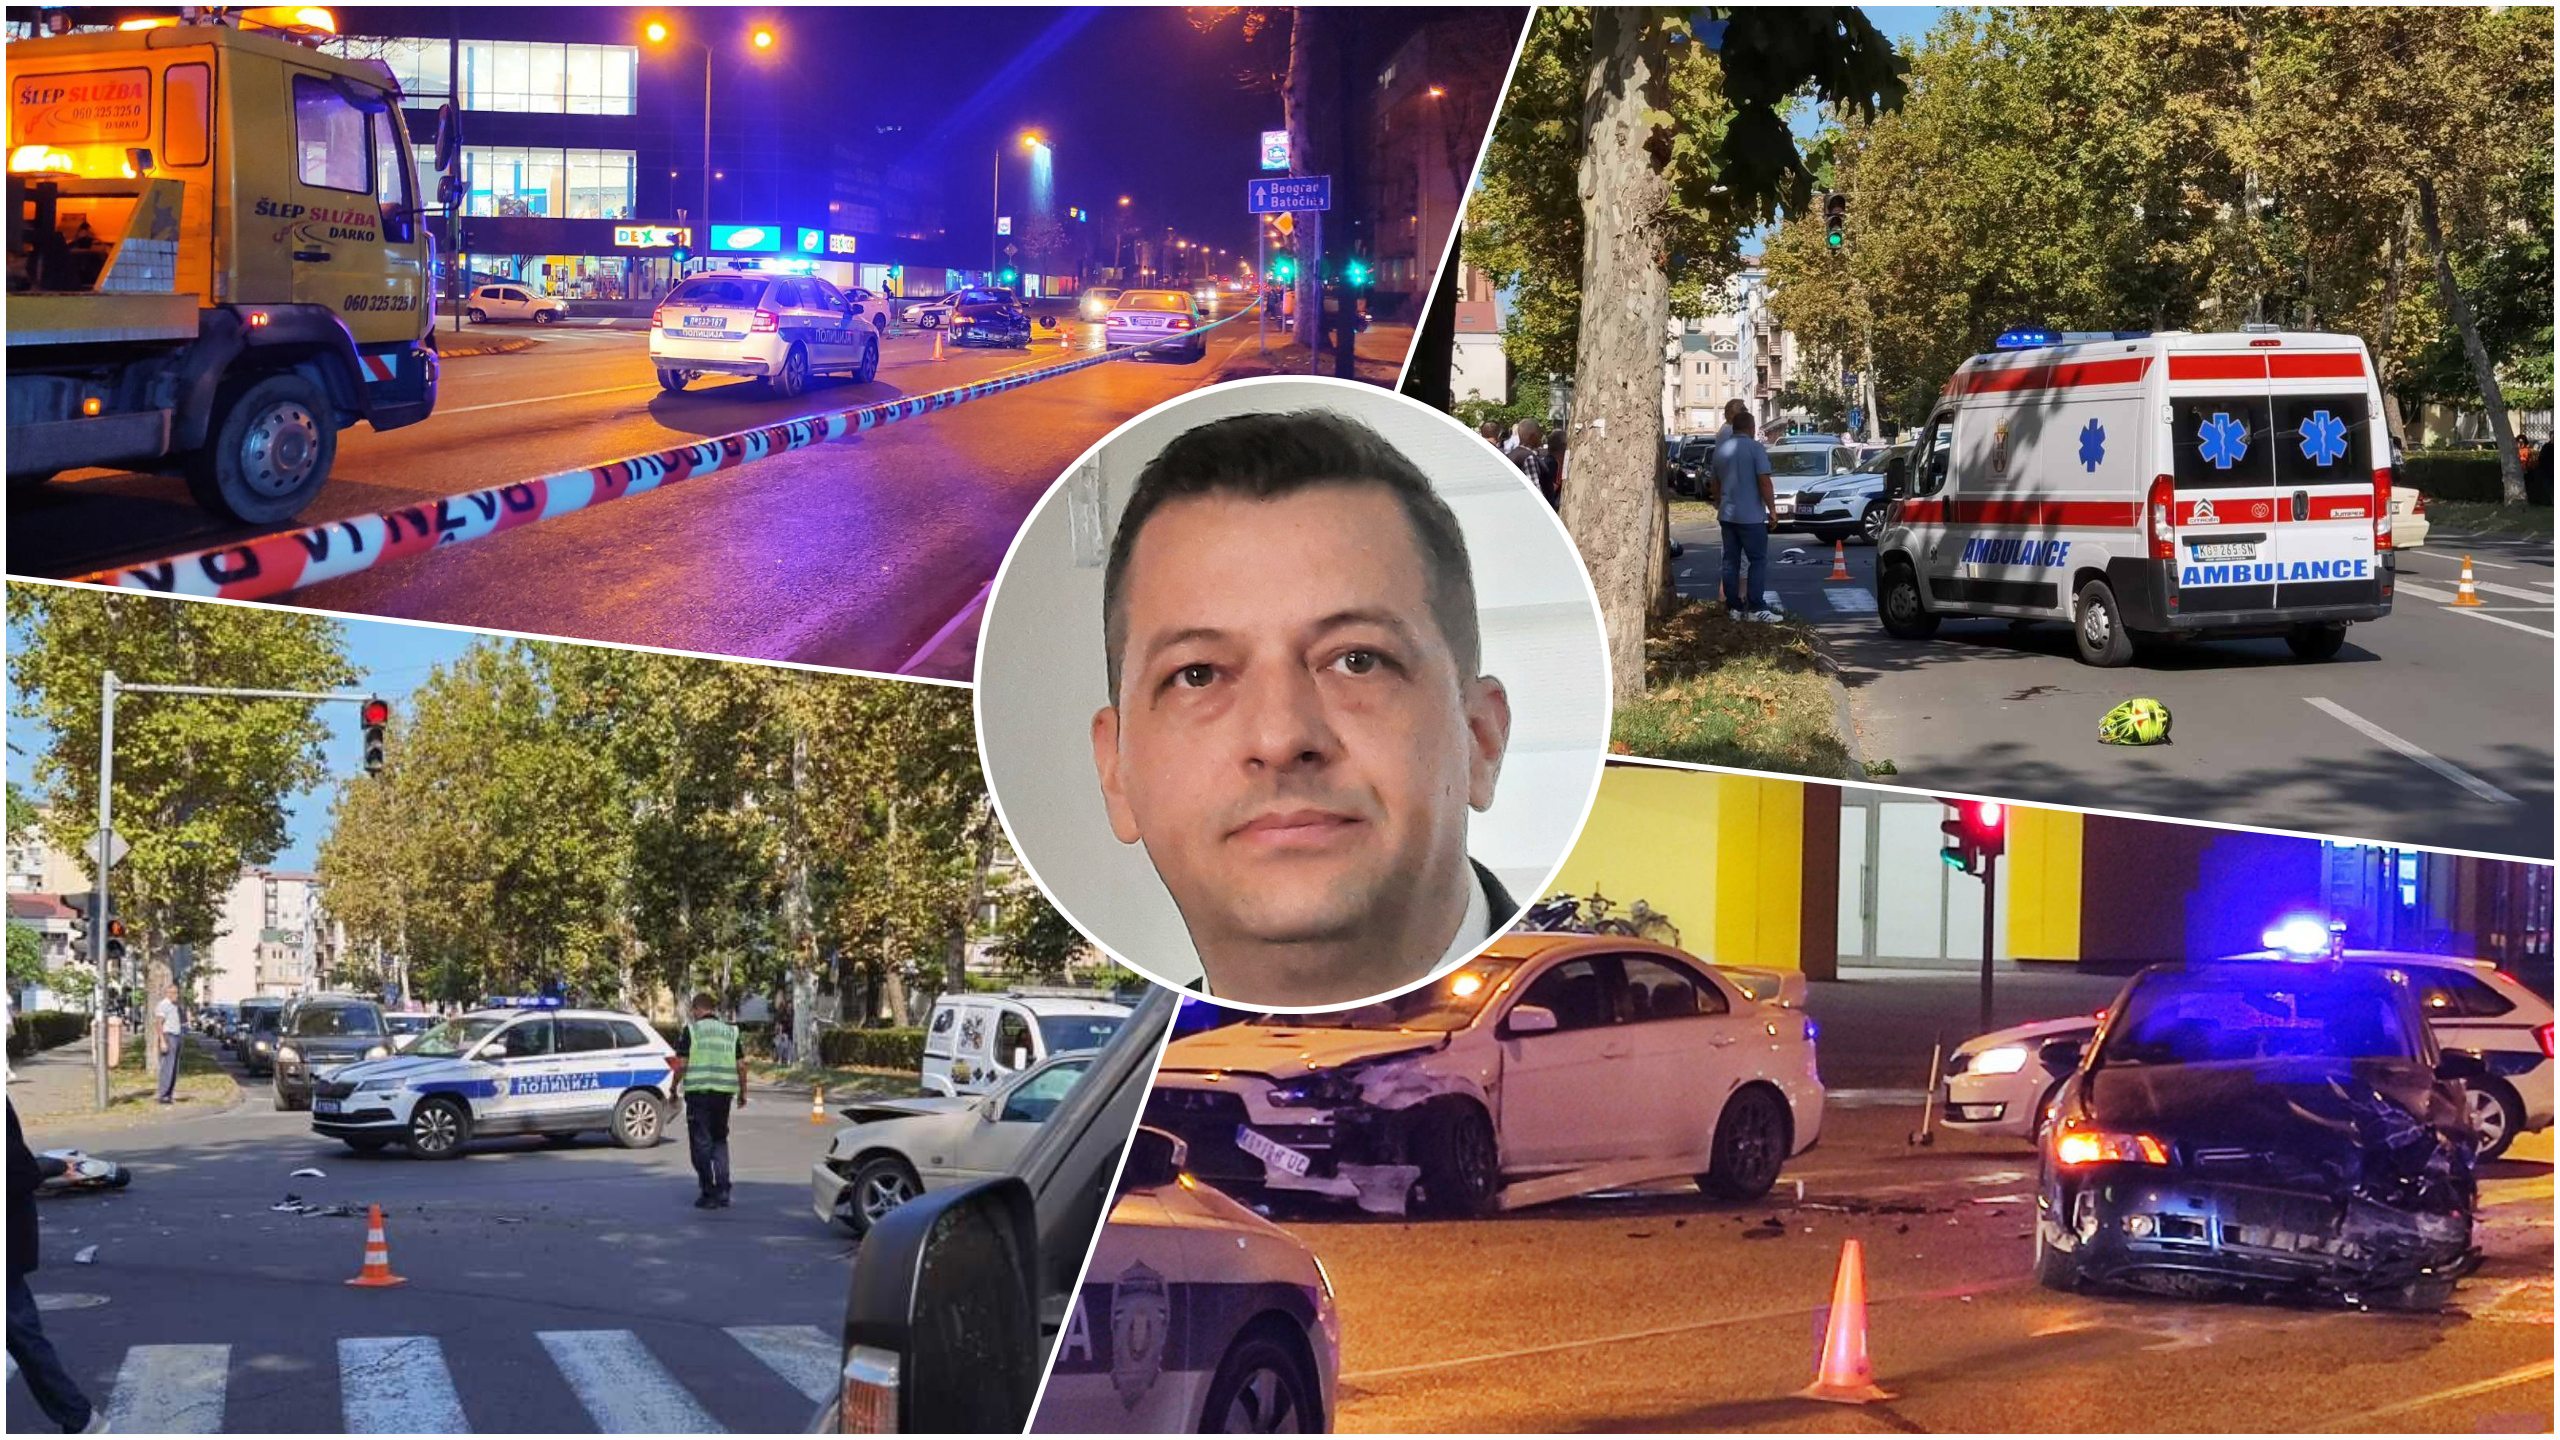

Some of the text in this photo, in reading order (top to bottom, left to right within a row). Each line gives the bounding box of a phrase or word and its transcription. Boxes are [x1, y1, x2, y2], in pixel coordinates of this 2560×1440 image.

[20, 81, 144, 105] ŠLEP SLUŽBA
[105, 120, 139, 129] DARKO
[255, 197, 376, 228] ŠLEP SLUŽBA
[328, 227, 375, 242] DARKO
[344, 295, 417, 311] 060 325 325 0
[682, 329, 725, 338] ПОЛИЦИЈА
[1961, 538, 2071, 567] AMBULANCE
[2200, 545, 2213, 556] KG
[2181, 559, 2367, 585] AMBULANCE
[519, 1079, 600, 1094] ПОЛИЦИЈА
